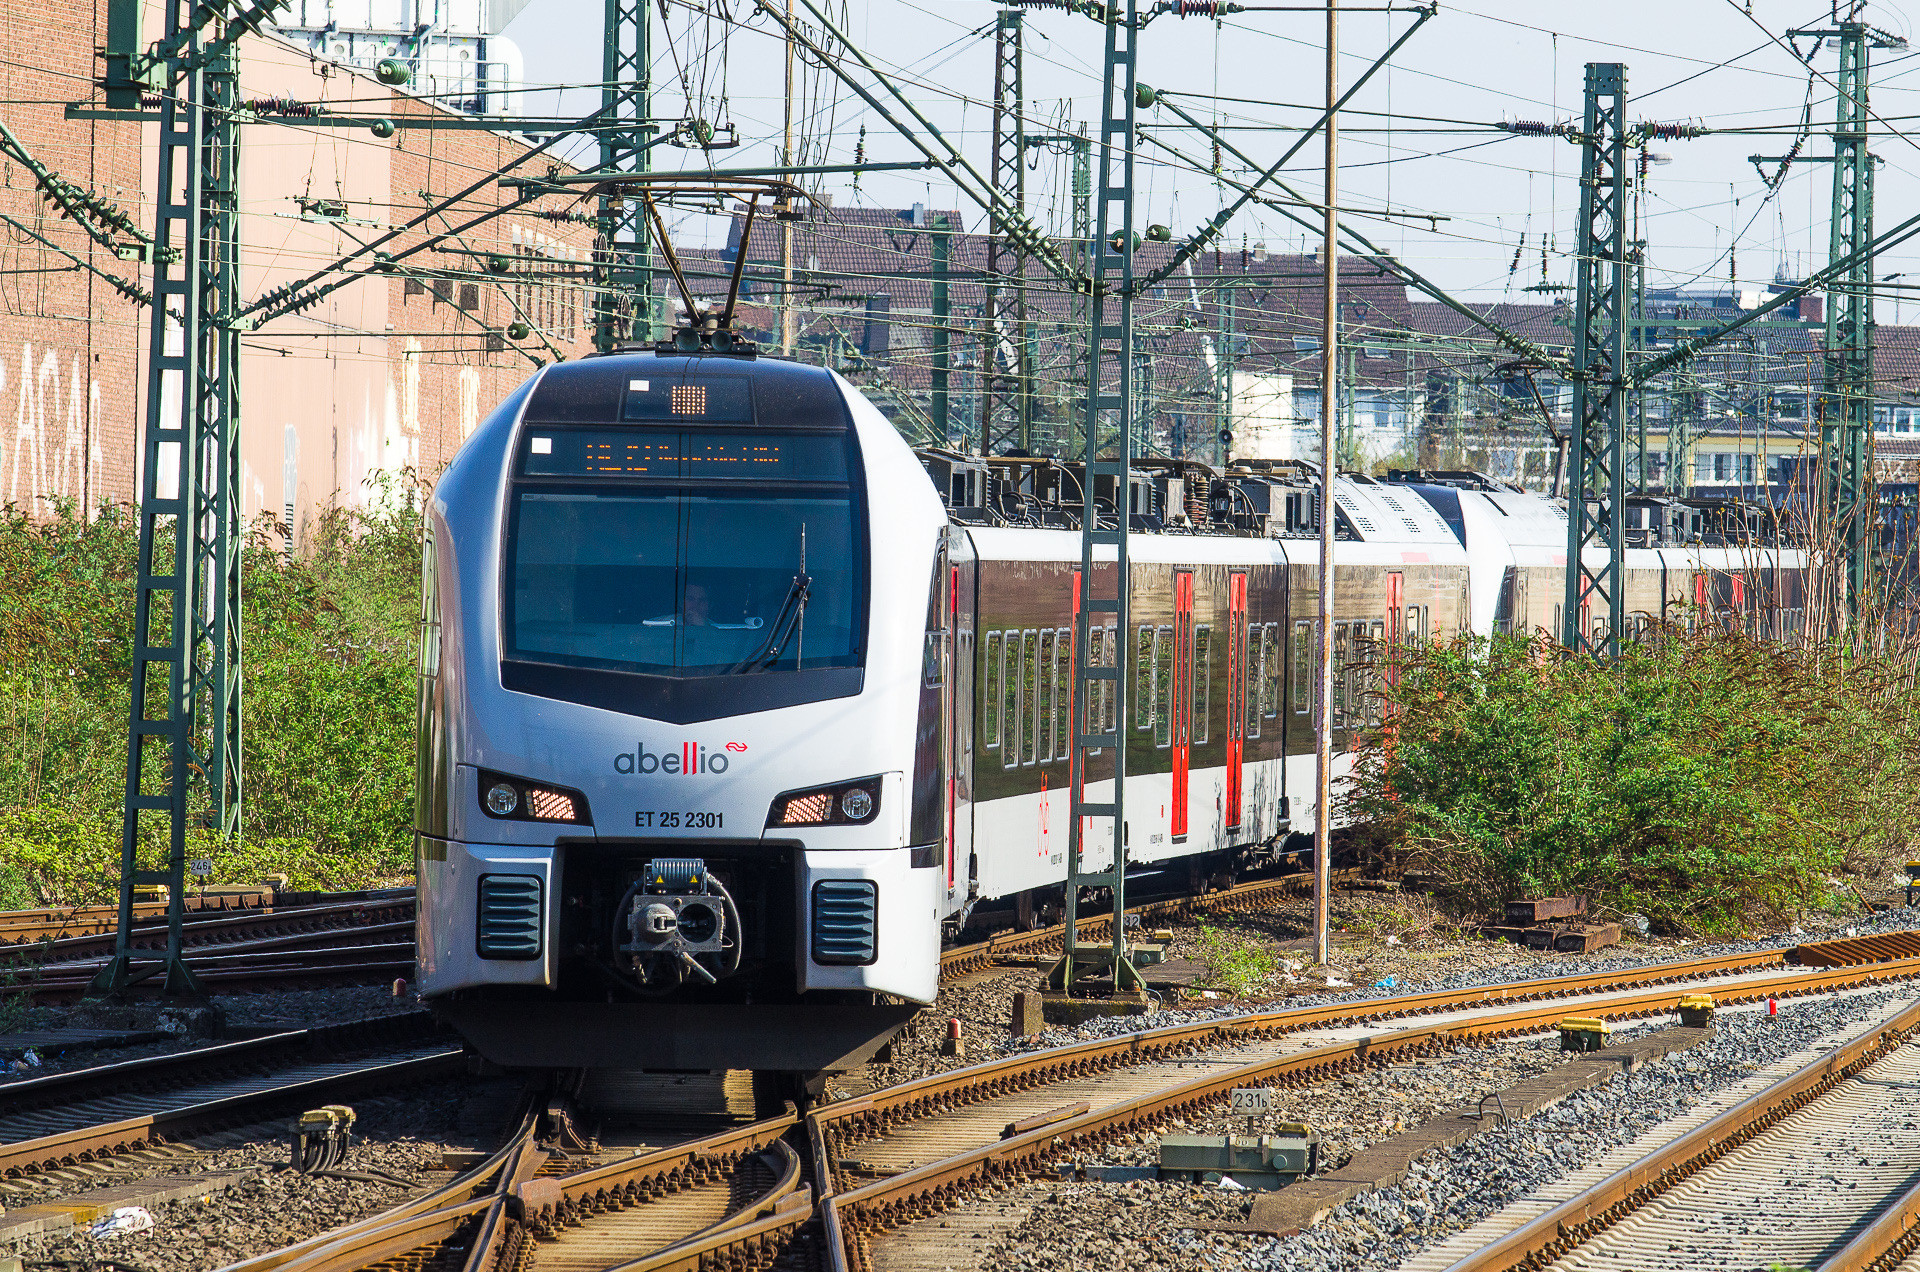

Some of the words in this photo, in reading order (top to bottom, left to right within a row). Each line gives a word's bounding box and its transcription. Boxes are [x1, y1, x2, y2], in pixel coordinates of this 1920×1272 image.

[613, 741, 730, 776] abellio
[635, 811, 655, 828] ET
[659, 811, 680, 828] 25
[684, 811, 724, 829] 2301
[1234, 1092, 1268, 1108] 231b
